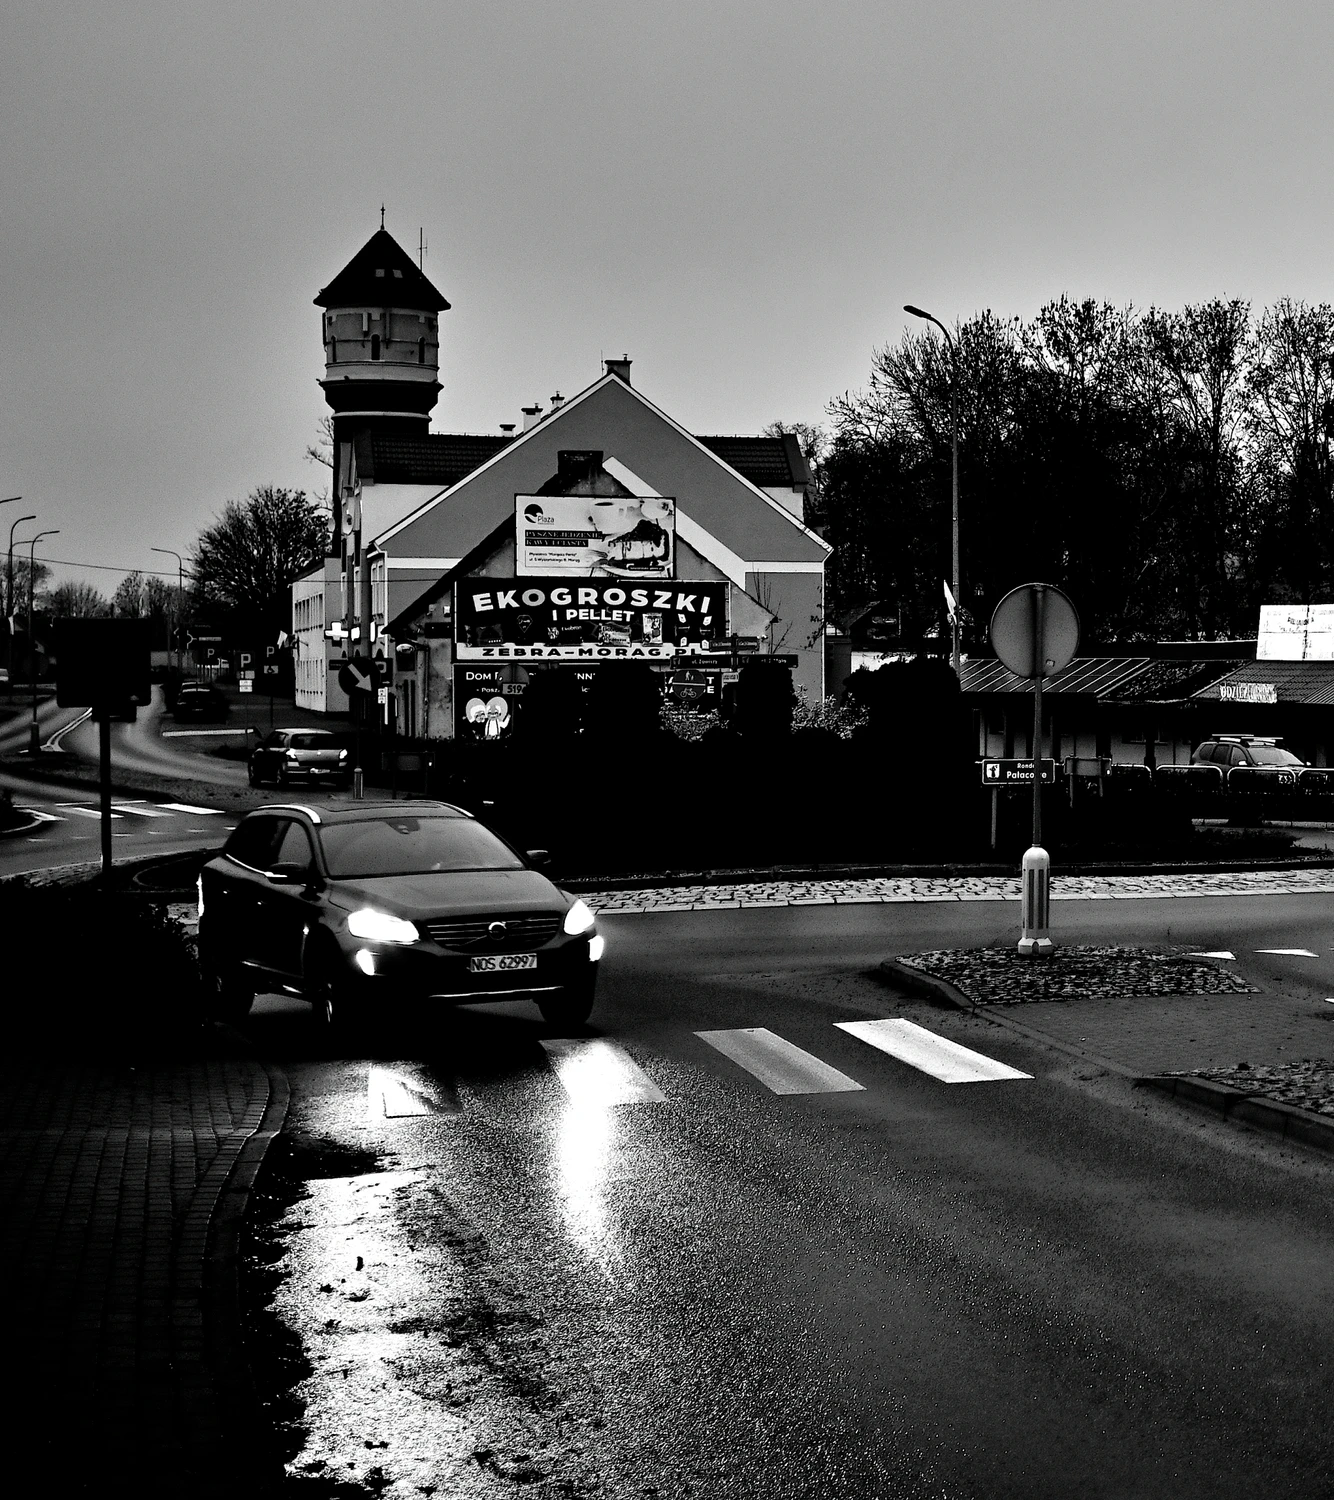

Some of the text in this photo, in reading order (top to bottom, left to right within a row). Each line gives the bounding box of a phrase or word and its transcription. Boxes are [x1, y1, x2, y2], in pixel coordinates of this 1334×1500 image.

[537, 515, 555, 523] Plaza
[471, 587, 711, 614] EKOGROSZKI
[553, 608, 635, 622] I PELLET
[240, 653, 252, 669] P
[466, 671, 492, 681] DOM
[471, 955, 536, 971] NOS 62997
